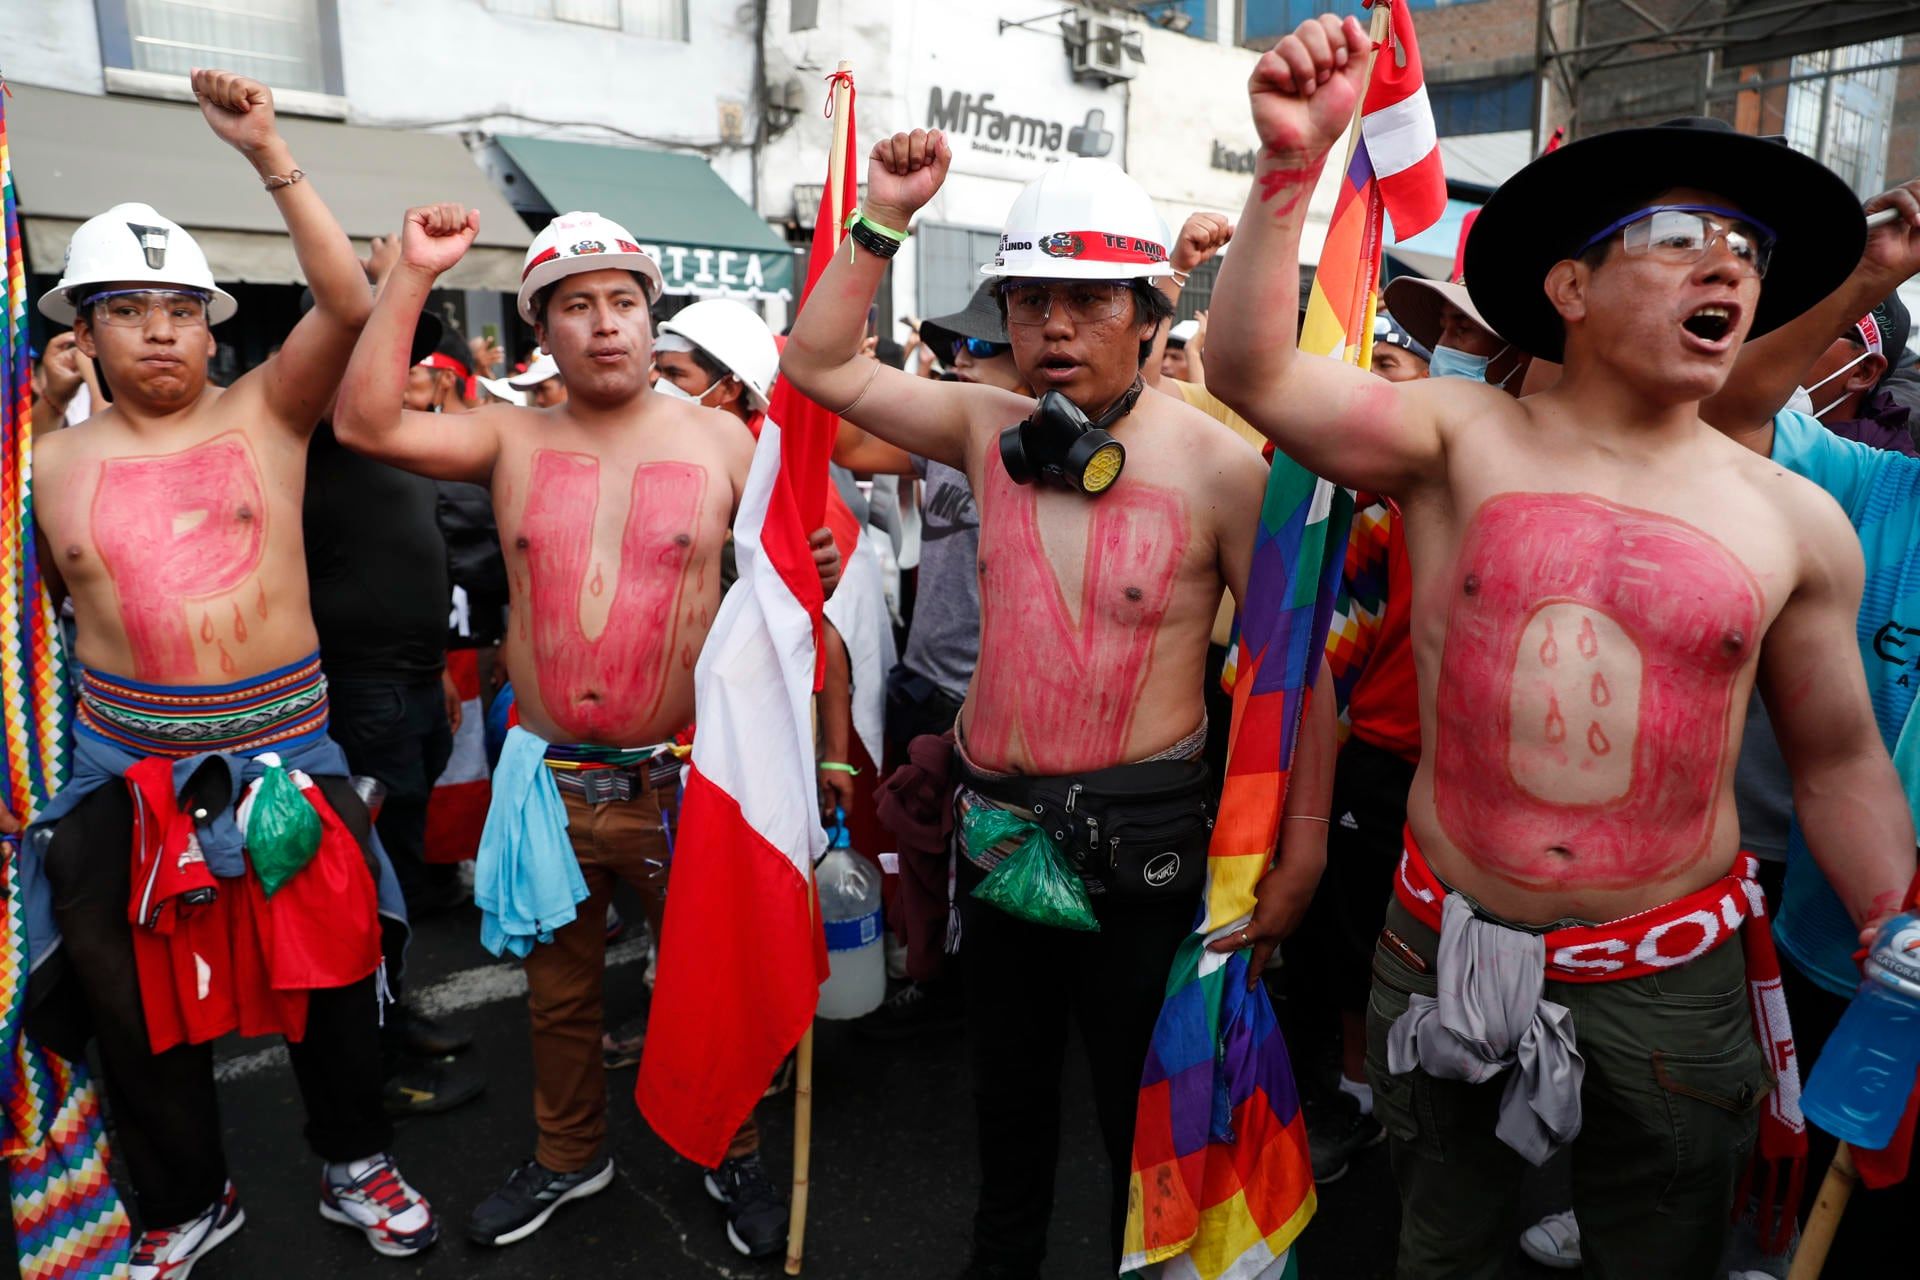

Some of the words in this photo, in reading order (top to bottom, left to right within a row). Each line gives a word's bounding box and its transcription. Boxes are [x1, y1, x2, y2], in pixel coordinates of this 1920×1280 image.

[927, 86, 1062, 150] Mifarma
[1004, 242, 1032, 251] LINDO
[1103, 234, 1127, 249] TE
